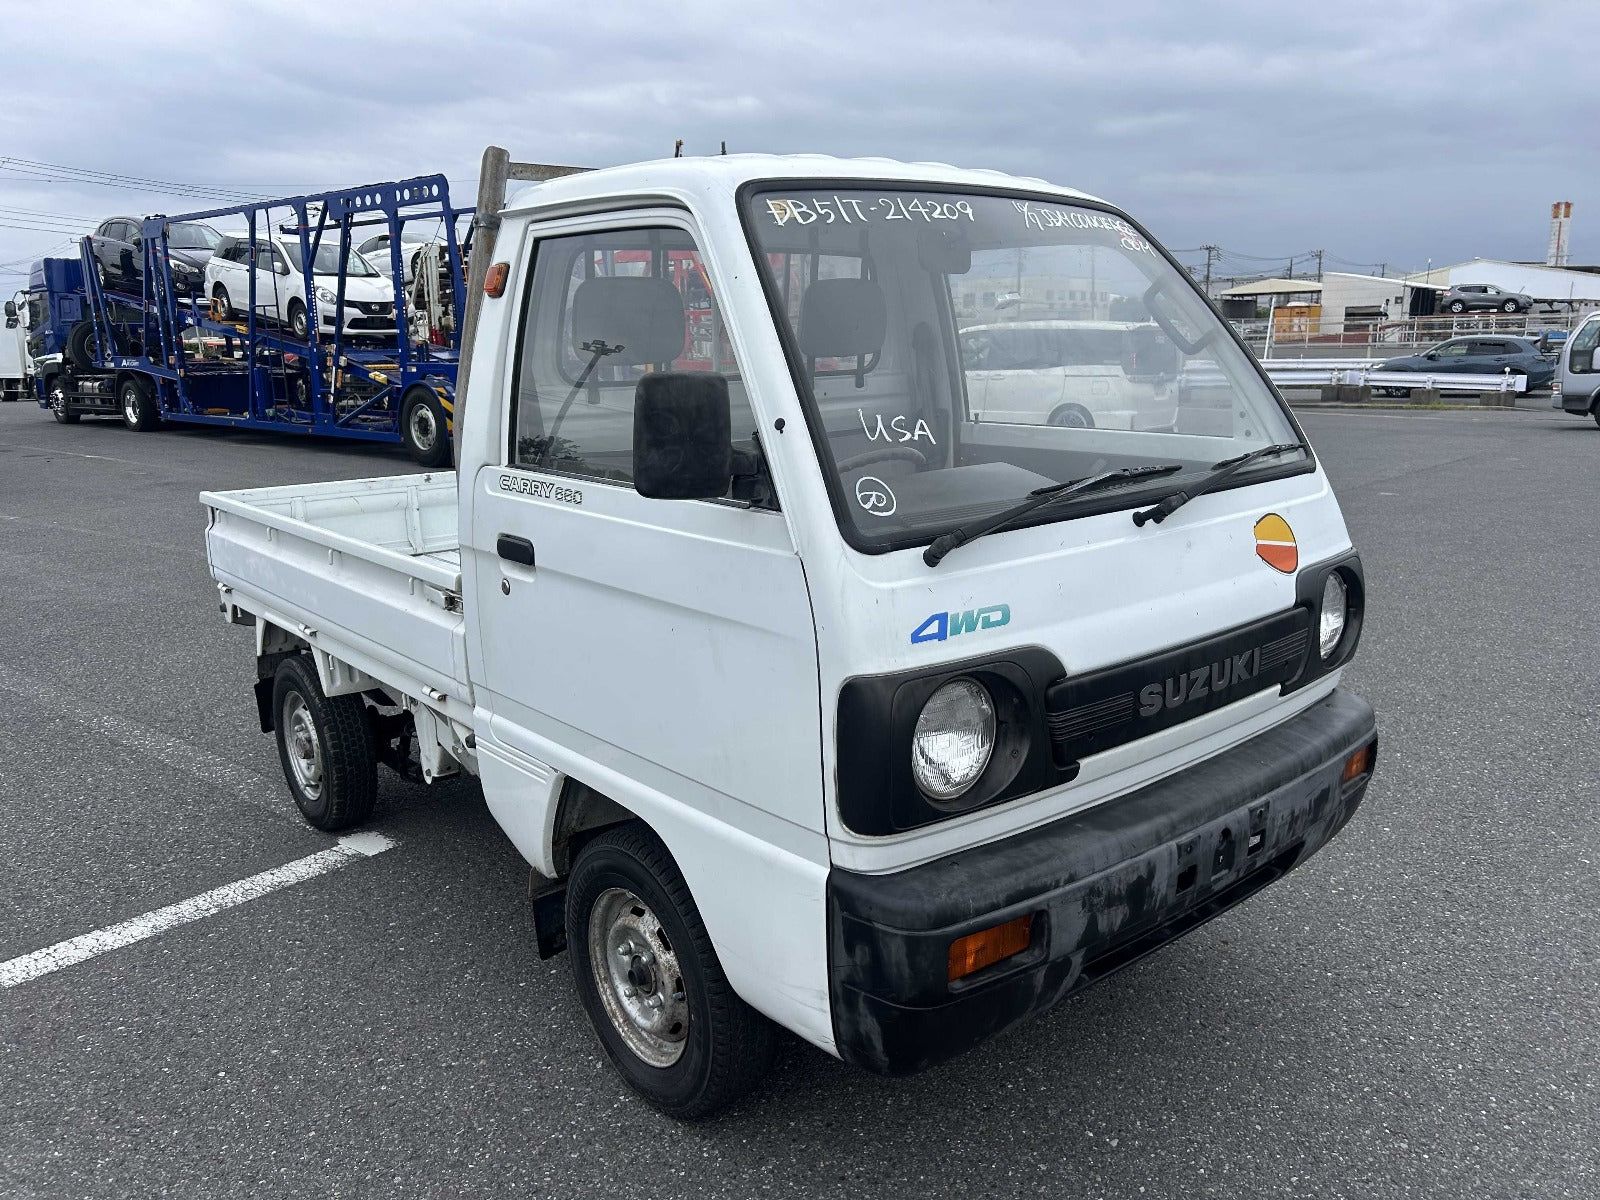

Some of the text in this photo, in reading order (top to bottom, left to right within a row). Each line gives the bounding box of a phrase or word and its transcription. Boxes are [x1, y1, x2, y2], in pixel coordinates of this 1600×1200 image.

[858, 408, 937, 445] USA
[499, 474, 554, 499] CARRY
[910, 603, 1011, 645] 4WD
[1138, 646, 1261, 718] SUZUKI
